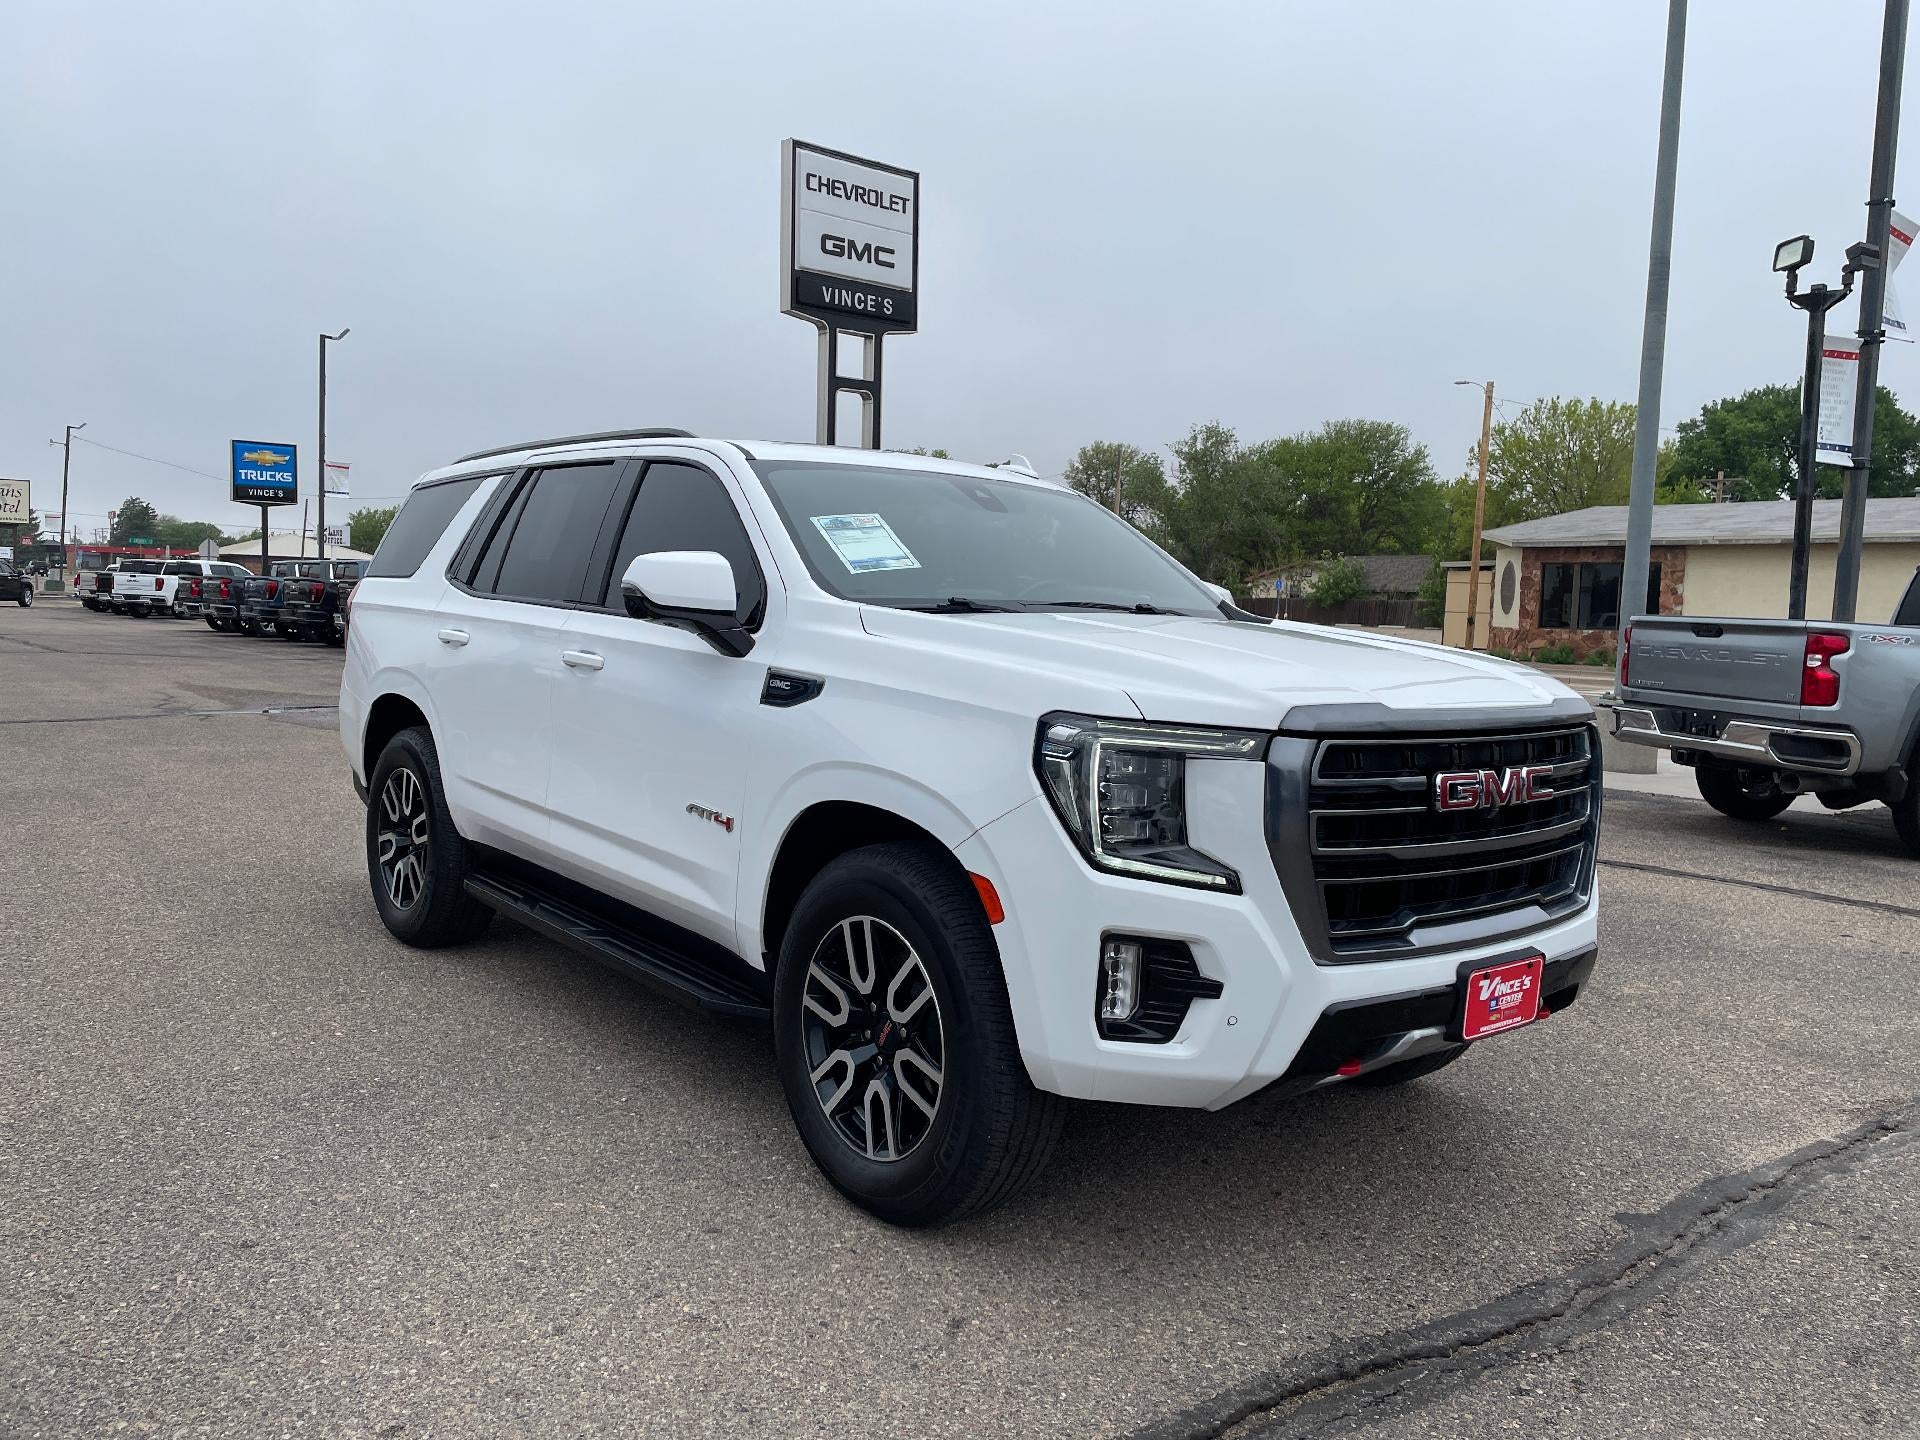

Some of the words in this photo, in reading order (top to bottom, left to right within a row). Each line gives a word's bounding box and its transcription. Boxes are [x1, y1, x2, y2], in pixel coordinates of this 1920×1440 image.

[806, 172, 910, 214] CHEVROLET
[820, 233, 895, 269] GMC
[822, 285, 893, 315] VINCE'S
[239, 470, 293, 482] TRUCKS
[248, 488, 284, 497] VINCE'S
[0, 500, 20, 513] tel
[1638, 646, 1788, 667] CHEVROLET
[770, 679, 791, 690] GMC
[1436, 766, 1553, 812] GMC
[686, 802, 734, 833] AT4
[1499, 992, 1523, 1005] CENTER
